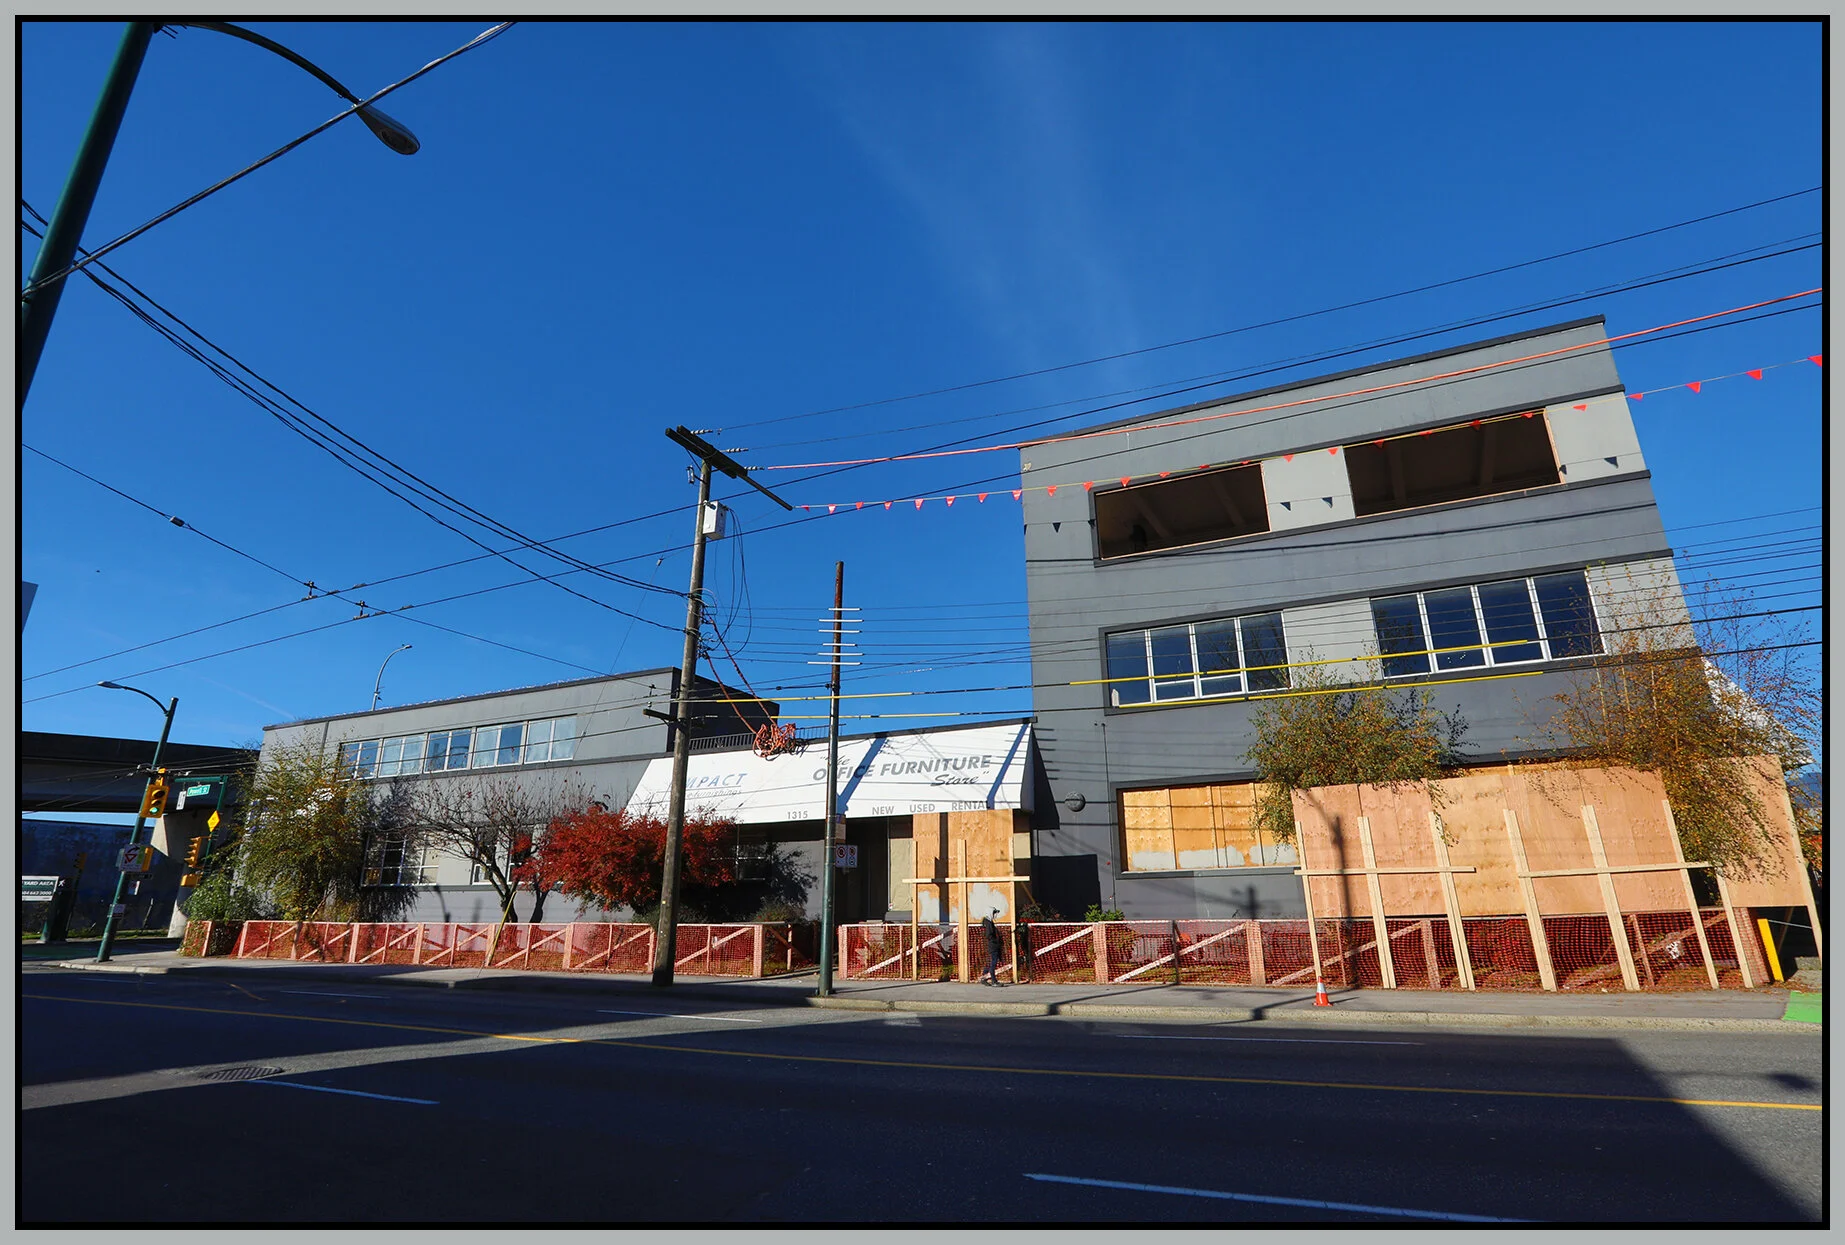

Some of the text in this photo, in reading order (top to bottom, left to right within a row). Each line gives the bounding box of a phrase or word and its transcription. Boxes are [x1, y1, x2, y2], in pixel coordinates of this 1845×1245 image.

[813, 755, 992, 781] OFICE FURNITURE
[685, 773, 747, 788] MPACT
[787, 811, 808, 819] 1315
[872, 806, 894, 815] NEW
[909, 804, 935, 813] USED
